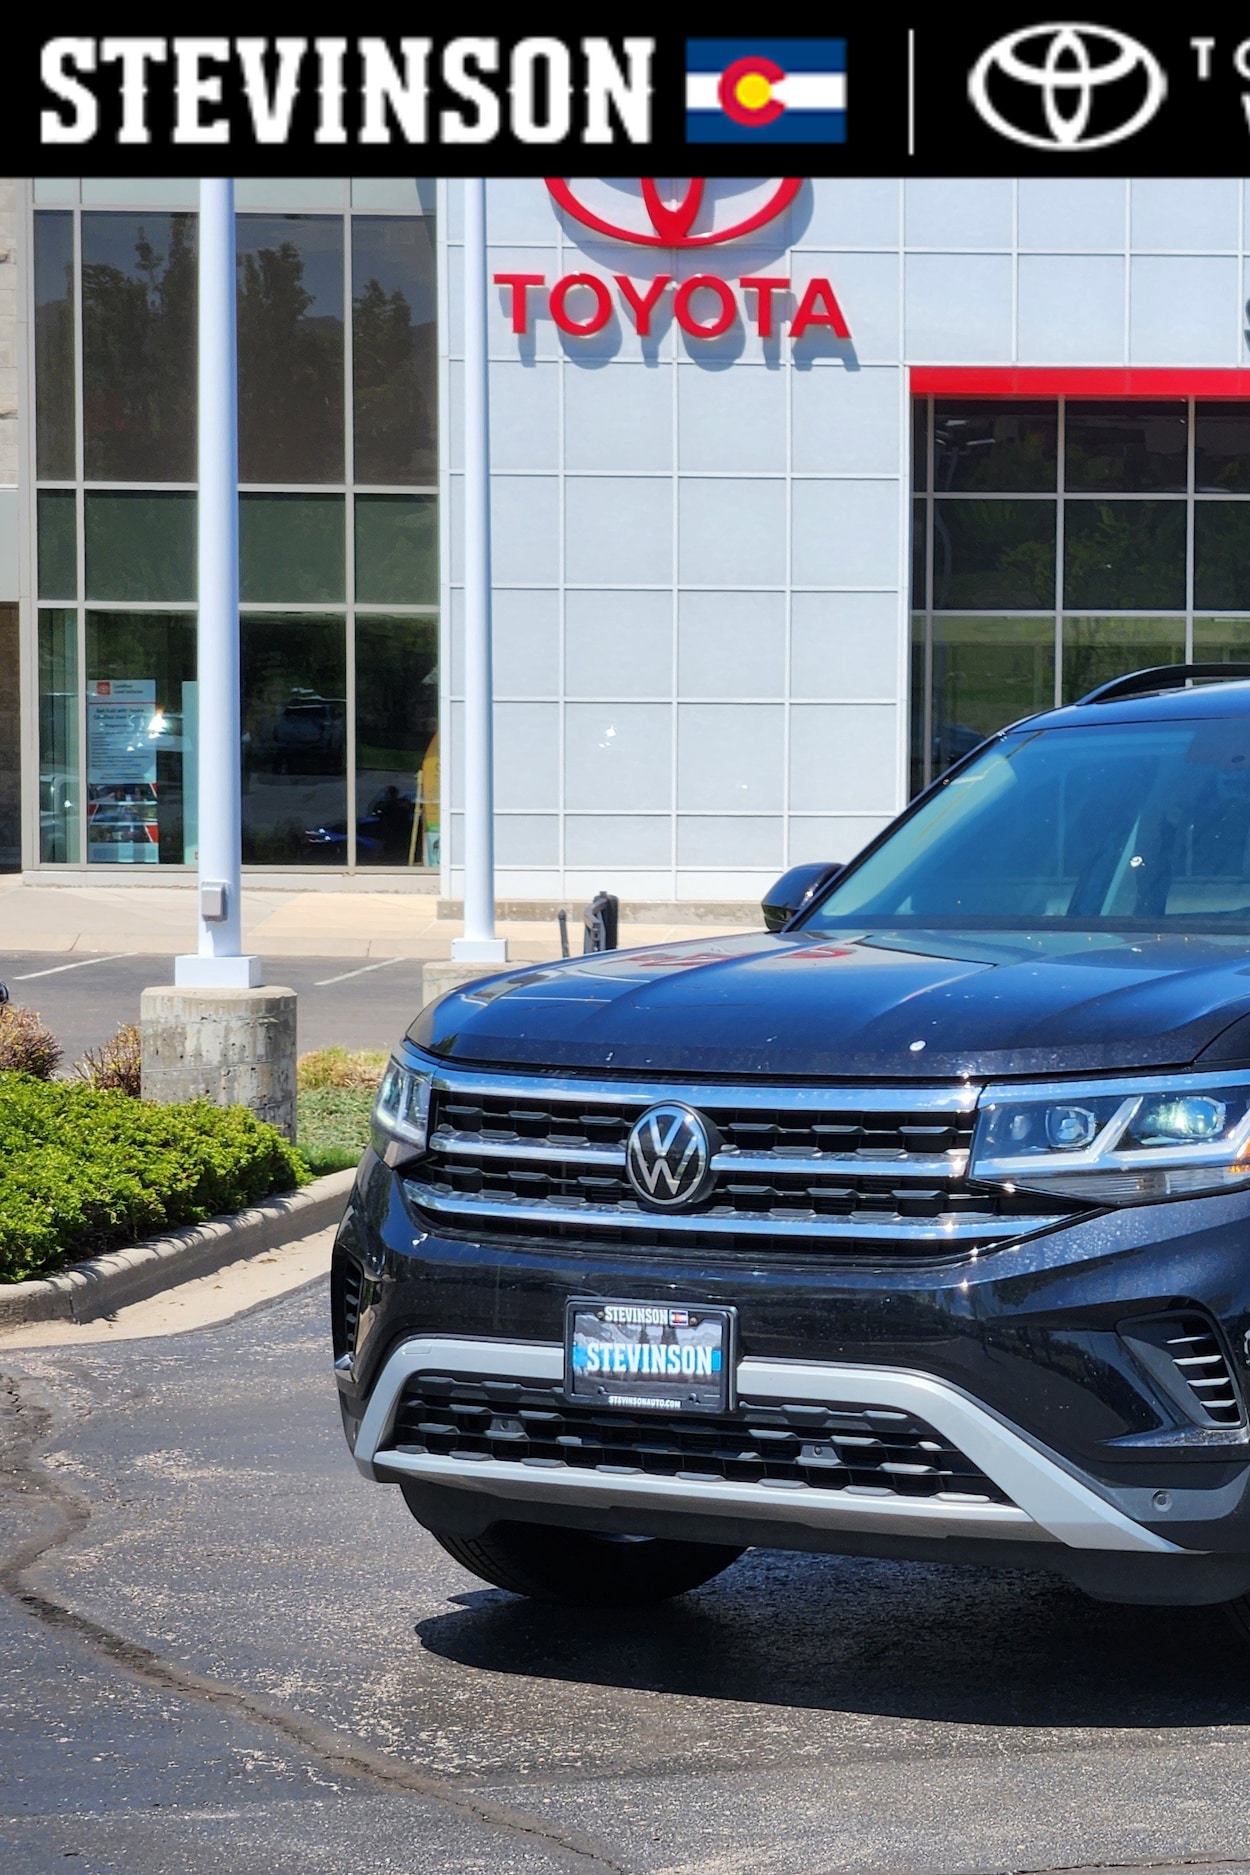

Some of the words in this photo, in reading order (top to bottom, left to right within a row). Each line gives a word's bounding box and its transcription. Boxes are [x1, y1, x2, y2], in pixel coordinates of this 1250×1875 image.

[494, 273, 851, 340] TOYOTA
[603, 1305, 669, 1325] STEVINSON
[586, 1342, 714, 1376] STEVINSON
[607, 1394, 682, 1409] STEVINSONAUTO.COM
